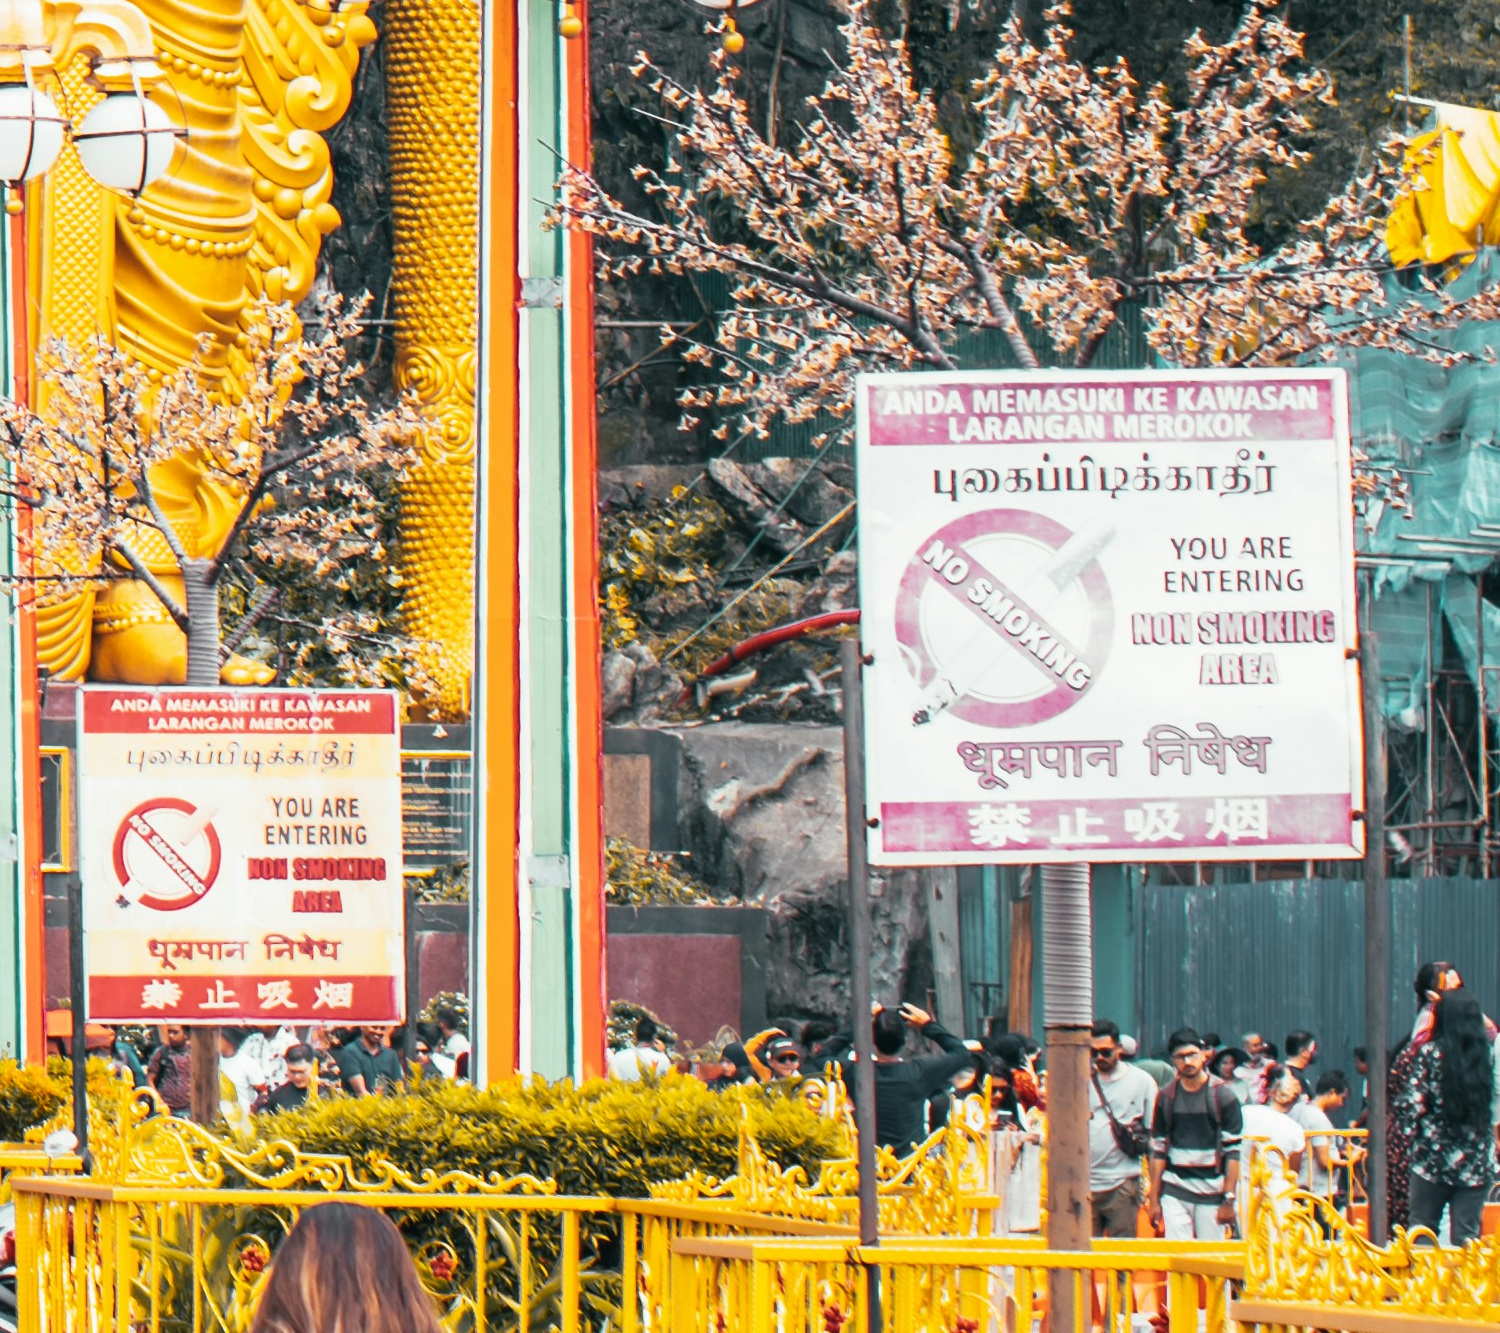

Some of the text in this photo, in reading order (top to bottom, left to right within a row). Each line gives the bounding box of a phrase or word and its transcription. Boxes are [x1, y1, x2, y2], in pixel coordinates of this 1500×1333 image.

[883, 385, 1318, 415] ANDA MEMASUKI KE KAWASAN
[948, 413, 1253, 443] LARANGAN MEROKOK
[933, 447, 1277, 501] புகைப்பிடிக்காதீர்
[1170, 535, 1294, 561] YOU ARE
[1164, 568, 1304, 593] ENTERING
[922, 539, 1093, 692] NO SMOKING
[1131, 609, 1336, 645] NON SMOKING
[1199, 653, 1278, 686] AREA
[111, 699, 370, 713] ANDA MEMASUKI KE KAWASAN
[148, 717, 334, 731] LARANGAN MEROKOK
[956, 722, 1273, 790] धूम्रपान निषेध
[272, 797, 360, 818] YOU ARE
[967, 797, 1269, 847] 禁止吸烟
[265, 825, 368, 845] ENTERING
[128, 814, 206, 896] NO SMOKING
[248, 857, 387, 881] NON SMOKING
[292, 890, 343, 913] AREA
[264, 933, 342, 962] निषेध
[140, 979, 354, 1010] 禁止吸烟
